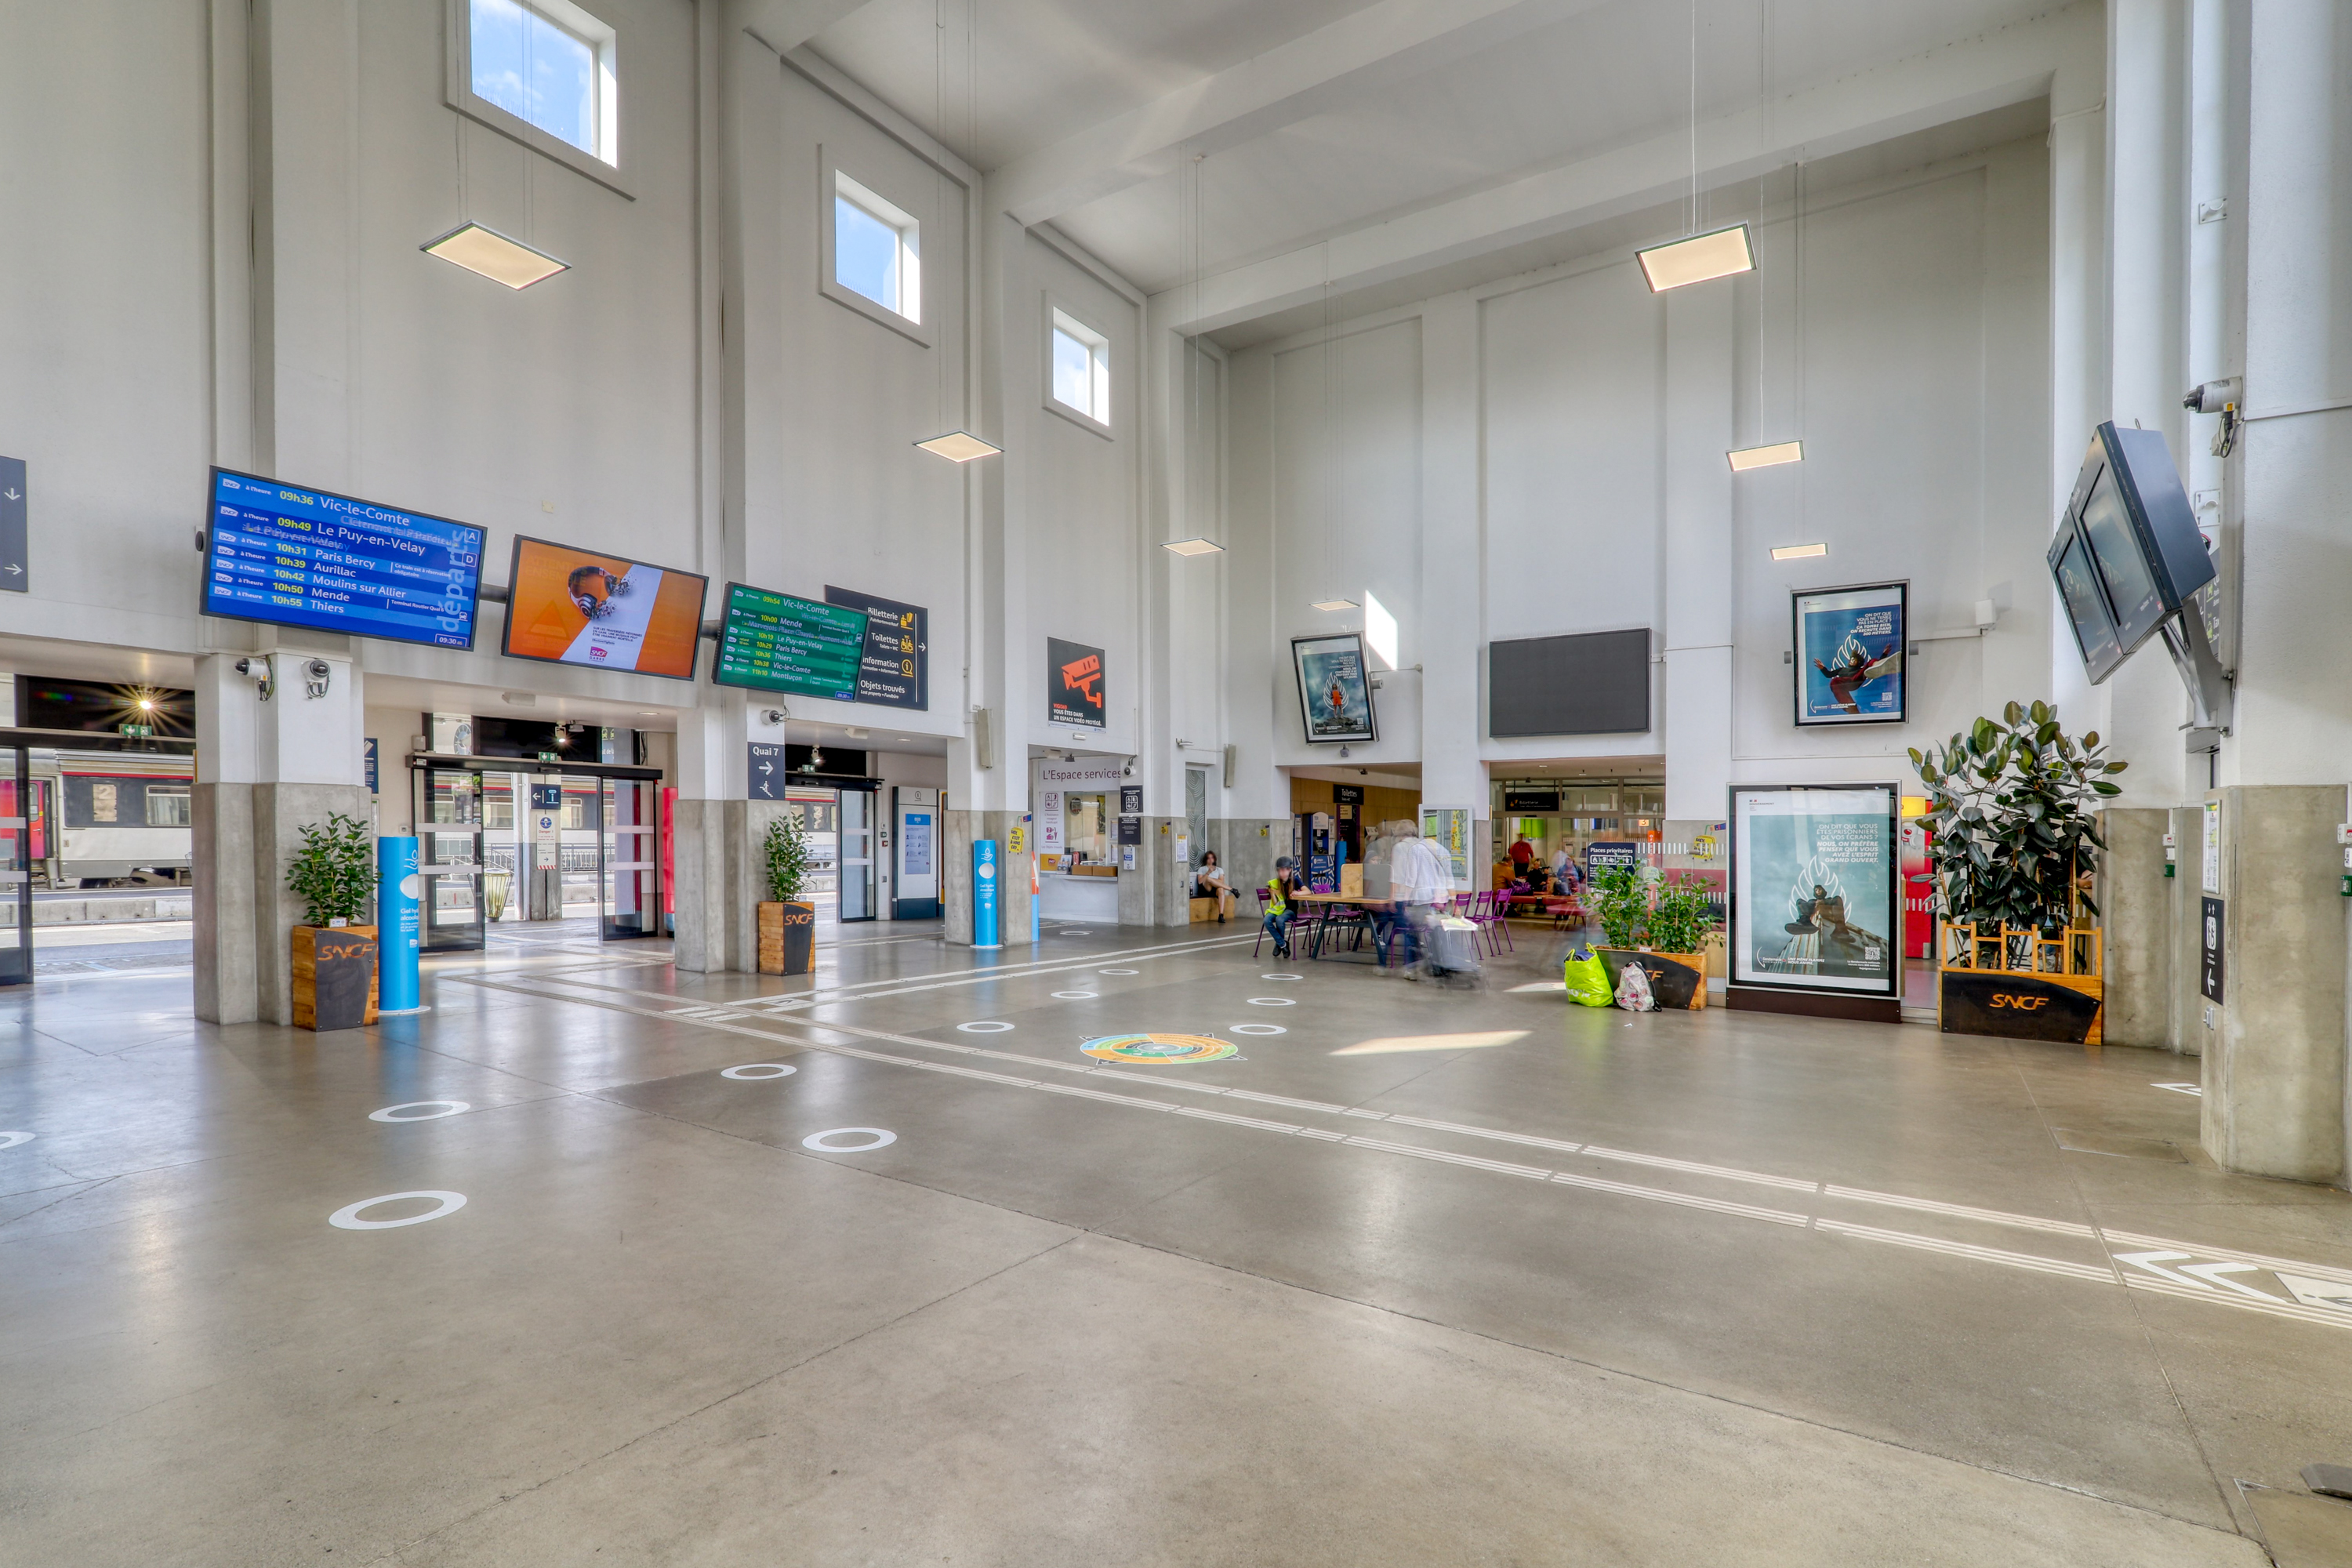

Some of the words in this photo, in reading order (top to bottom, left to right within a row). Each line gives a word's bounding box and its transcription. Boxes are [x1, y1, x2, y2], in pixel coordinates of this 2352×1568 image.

[250, 486, 272, 495] l'heure
[280, 491, 314, 505] 09h36
[319, 496, 410, 526] Vic-le-Comte
[248, 513, 269, 522] l'heure
[278, 517, 311, 531] 09h49
[318, 523, 334, 536] Le
[338, 527, 426, 556] Puy-en-Velay
[469, 532, 476, 541] A
[246, 538, 267, 547] l'heure
[276, 543, 307, 555] 10h31
[315, 550, 342, 563] Paris
[345, 556, 376, 570] Bercy
[466, 555, 474, 564] D
[245, 552, 266, 560] l'heure
[275, 556, 306, 568] 10h39
[314, 563, 356, 578] Aurillac
[394, 569, 420, 578] obligatoire
[426, 568, 451, 578] réservation
[244, 565, 265, 573] l'heure
[274, 569, 305, 581] 10h42
[313, 575, 356, 590] Moulins
[359, 584, 376, 593] sur
[378, 586, 407, 599] Allier
[437, 529, 469, 633] départs
[243, 578, 263, 587] l'heure
[273, 583, 303, 594] 10h50
[311, 588, 350, 602] Mende
[242, 591, 263, 600] l'heure
[272, 595, 302, 607] 10h55
[310, 599, 345, 614] Thiers
[391, 599, 411, 608] Terminal
[763, 596, 780, 605] 09h54
[783, 598, 829, 615] Vic-le-Comte
[867, 607, 898, 620] Billetterie
[761, 614, 777, 623] 10h00
[780, 617, 802, 628] Mende
[439, 637, 457, 645] 09:30
[786, 636, 823, 650] Puy-en-Velay
[871, 632, 898, 645] Toilettes
[776, 644, 790, 652] Paris
[791, 646, 807, 656] Bercy
[775, 653, 792, 662] Thiers
[773, 662, 811, 674] Vic-le-Comte
[771, 671, 802, 682] Montluçon
[860, 680, 881, 690] Objets
[882, 683, 905, 693] trouvés
[753, 746, 772, 756] Quai
[773, 748, 779, 756] 7
[1043, 770, 1082, 782] L'Espace
[1085, 768, 1121, 779] services
[99, 786, 111, 799] 2
[1341, 789, 1357, 797] Toilettes
[784, 914, 813, 926] SNCF
[317, 942, 376, 961] SNCF
[1989, 993, 2049, 1011] SNCF
